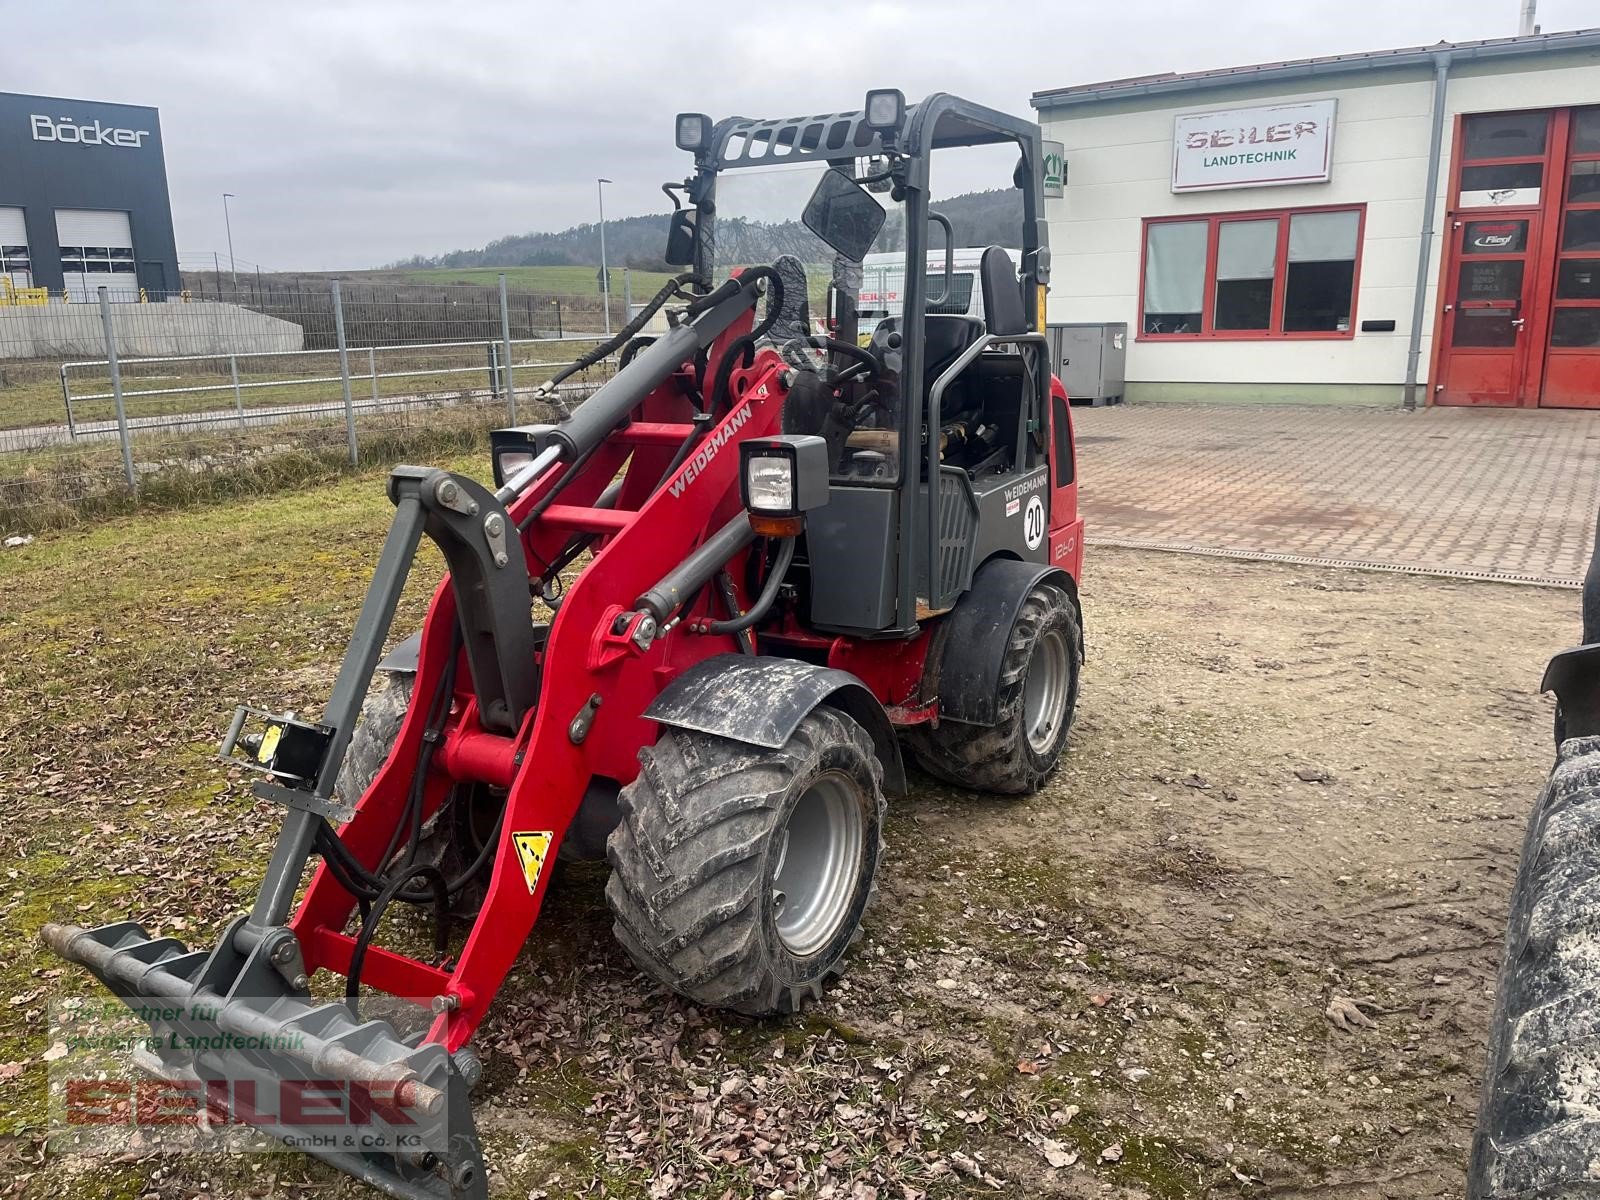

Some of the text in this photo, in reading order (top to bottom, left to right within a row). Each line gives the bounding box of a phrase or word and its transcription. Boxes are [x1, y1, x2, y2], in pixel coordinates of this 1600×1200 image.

[30, 114, 150, 148] Böcker
[1186, 121, 1318, 149] SEILER
[1203, 149, 1297, 168] LANDTECHNIK
[1485, 235, 1513, 246] Fliegl
[668, 402, 753, 498] WEIDEMANN
[1004, 474, 1048, 502] WEIDEMANN
[1028, 505, 1041, 542] 20
[1055, 537, 1075, 560] 1260
